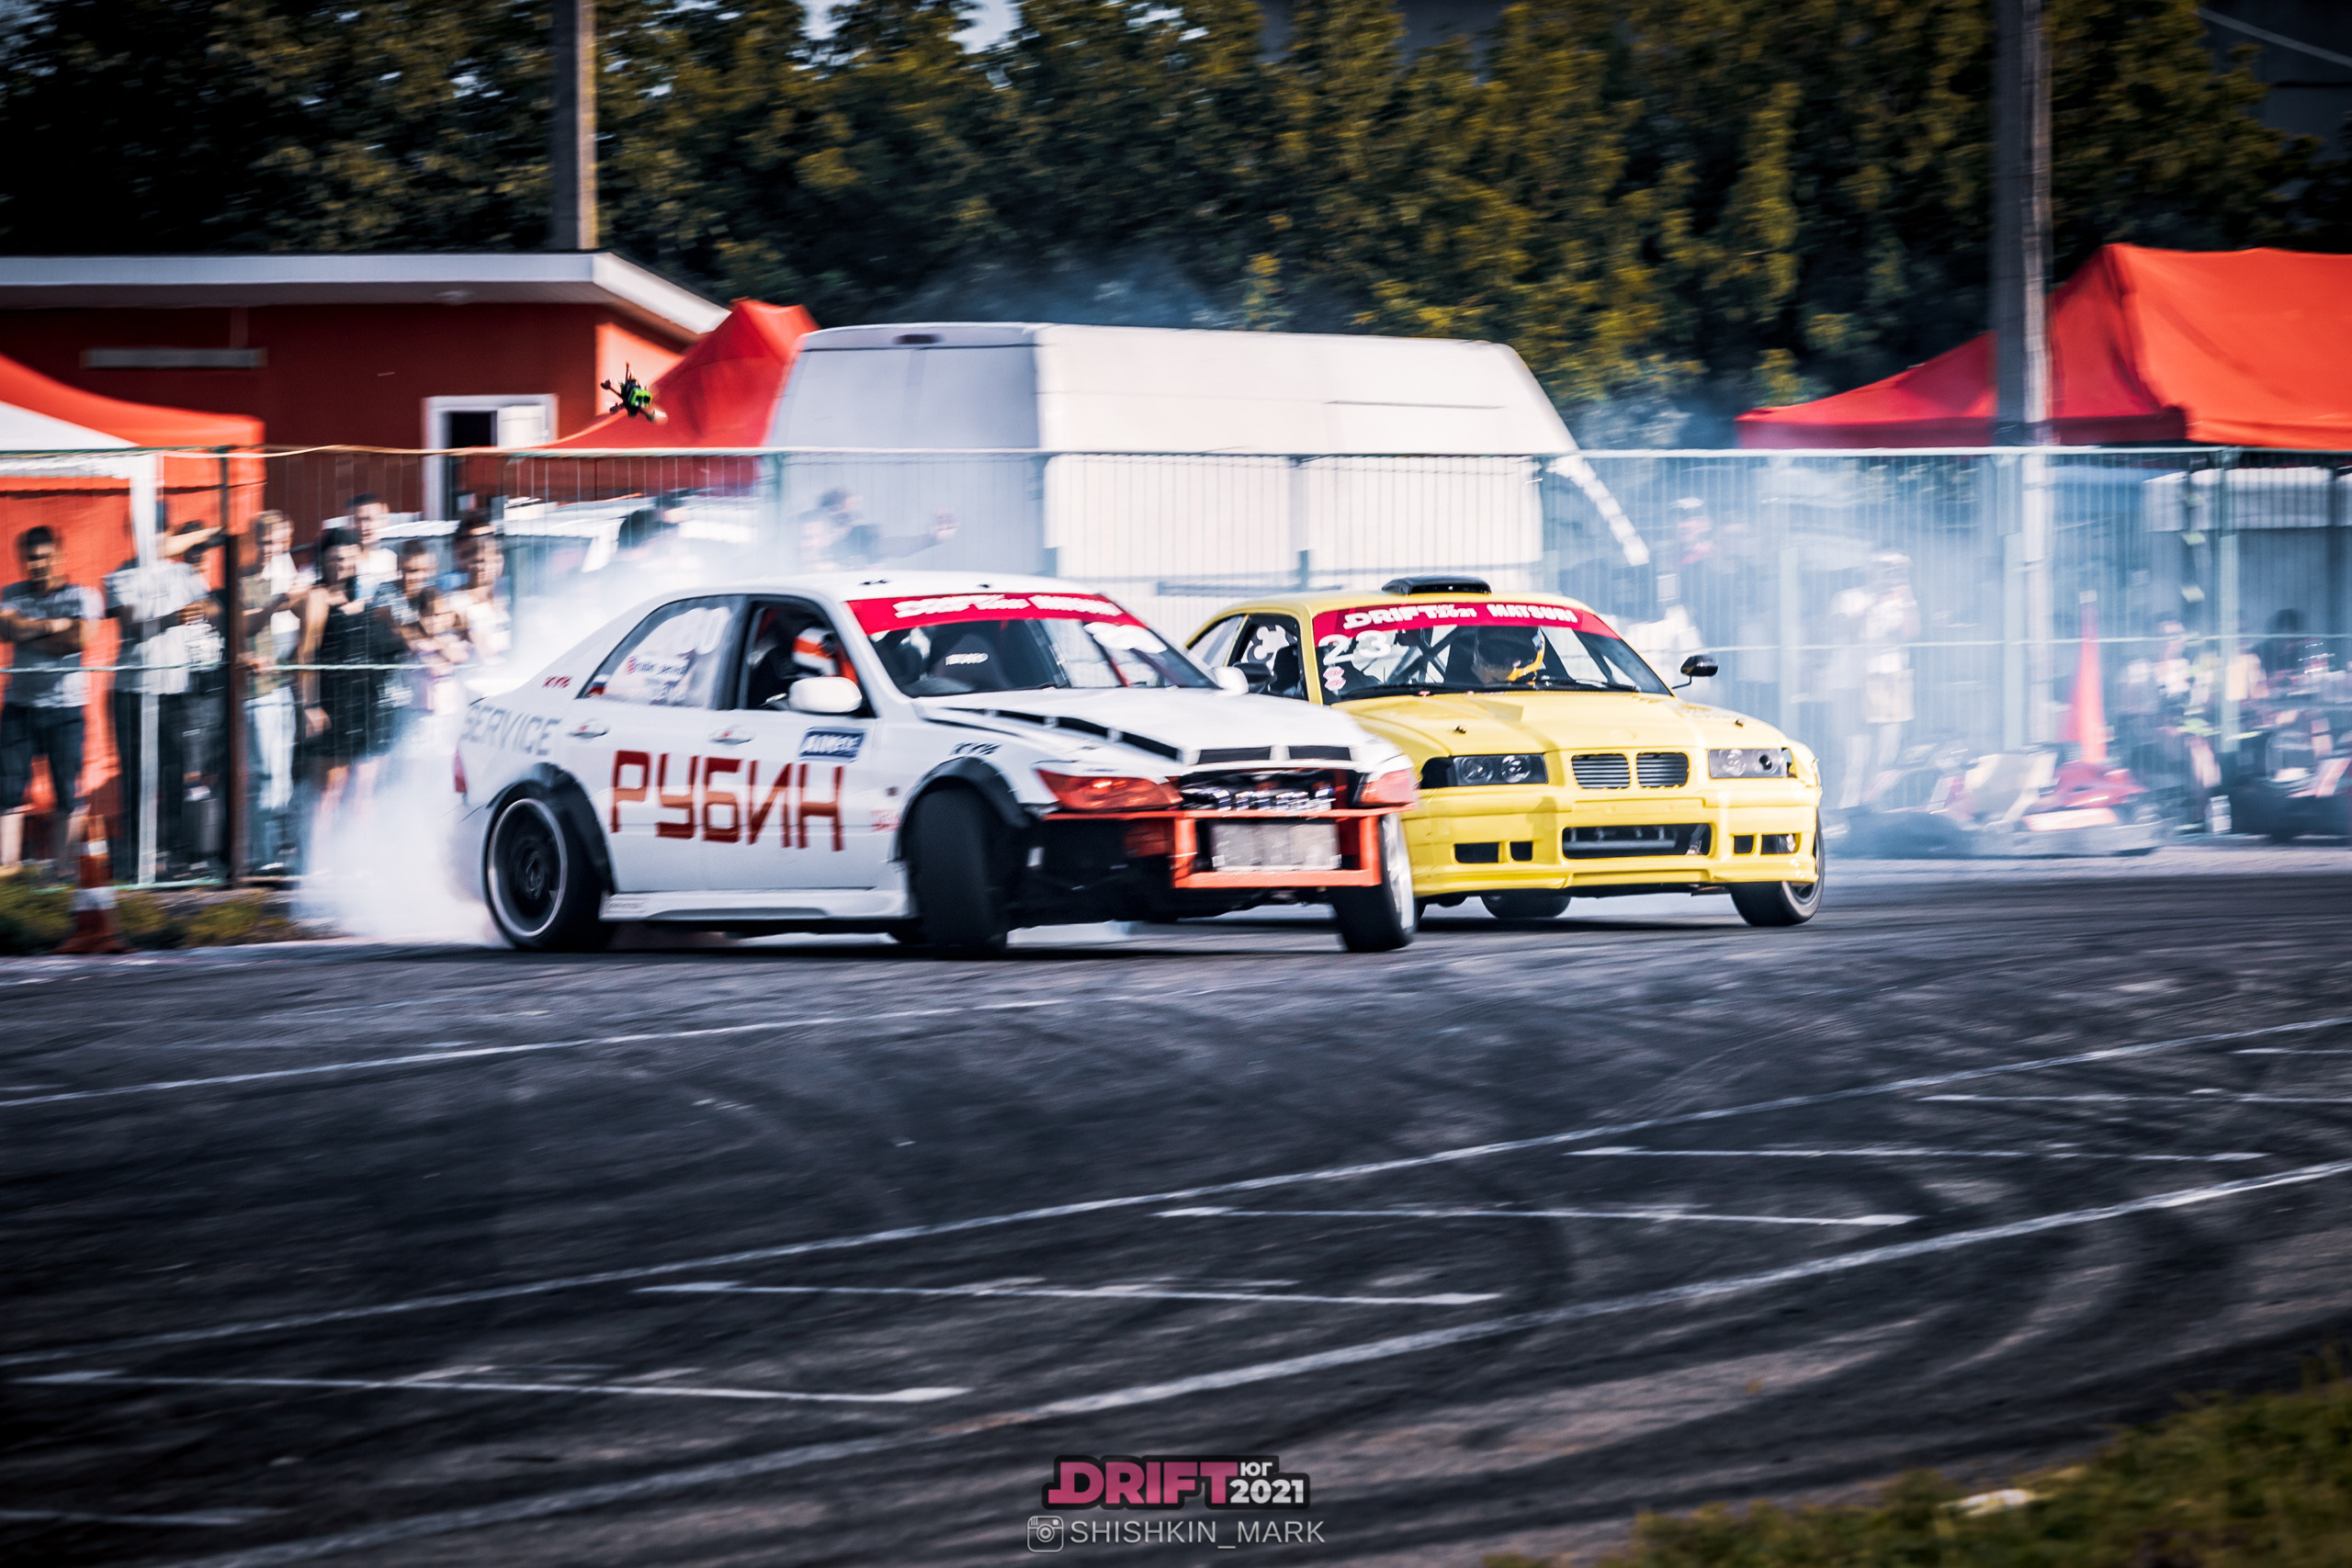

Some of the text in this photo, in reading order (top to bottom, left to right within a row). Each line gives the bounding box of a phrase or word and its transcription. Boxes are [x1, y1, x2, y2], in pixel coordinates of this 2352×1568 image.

[1343, 604, 1437, 629] DRIFT
[1487, 604, 1577, 623] MATSURI
[1318, 630, 1392, 665] 23
[460, 705, 561, 756] SERVICE
[611, 750, 845, 852] РУБИН
